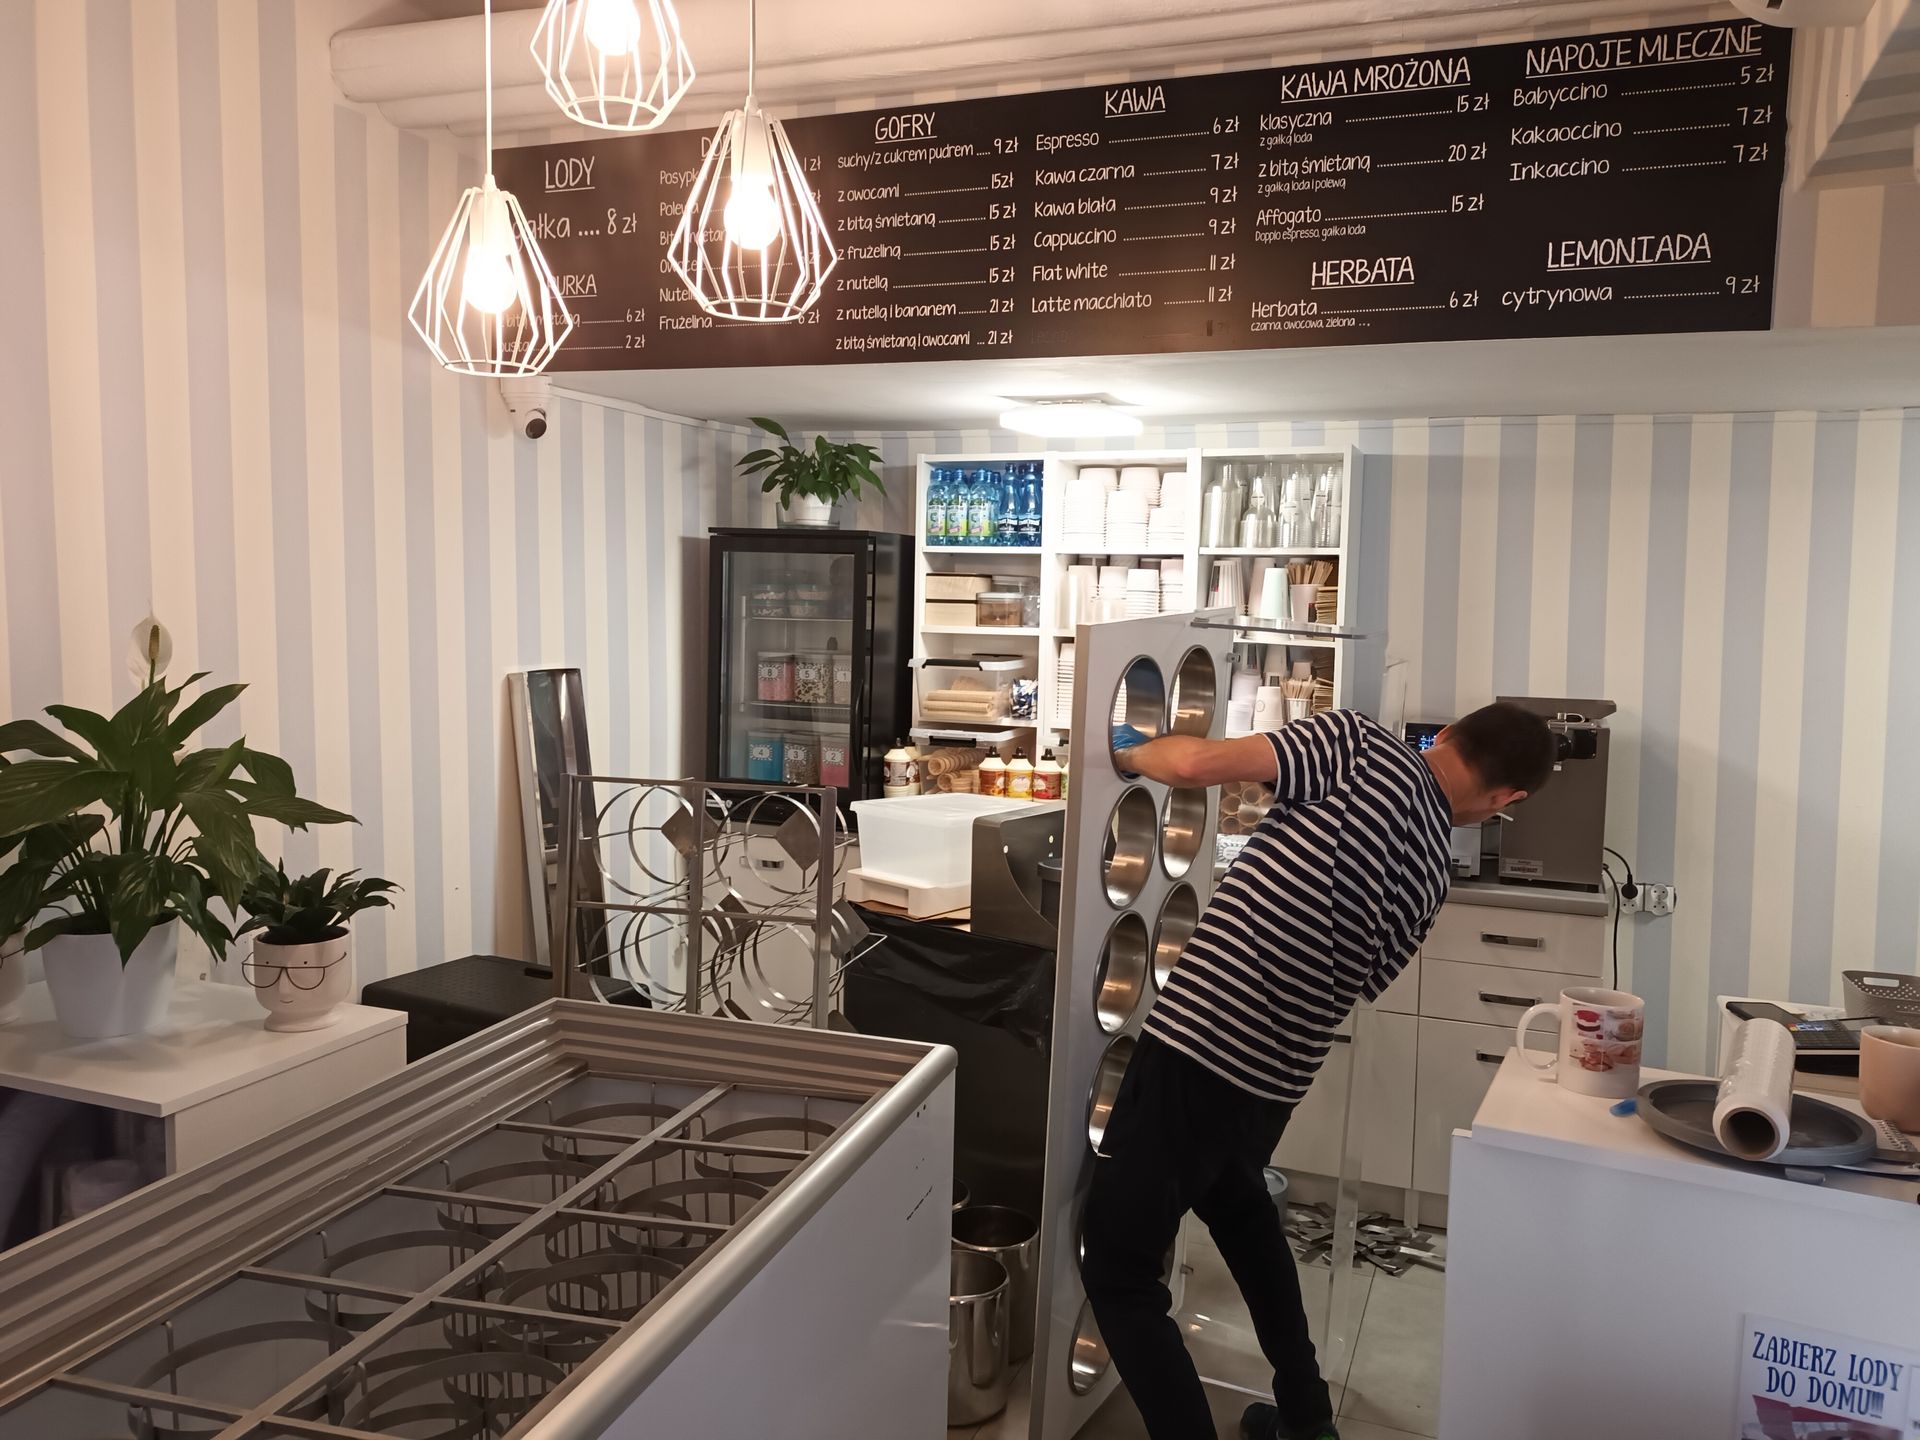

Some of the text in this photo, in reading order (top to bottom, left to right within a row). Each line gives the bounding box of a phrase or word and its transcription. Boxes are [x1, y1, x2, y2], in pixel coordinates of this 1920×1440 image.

[1525, 24, 1763, 75] NAPOJE MLECZNE
[1281, 56, 1471, 100] KAWA MROŻONA
[1513, 64, 1775, 110] Babyccino 5 zł
[1105, 85, 1166, 115] KAWA
[1260, 92, 1490, 134] klasyczna 15 zł
[875, 112, 936, 140] GOFRY
[1036, 115, 1240, 154] Espresso 6 zł
[1511, 105, 1773, 146] Kakaoccino 7 zł
[884, 149, 927, 164] cukrem
[929, 144, 974, 164] pudrem
[994, 139, 1002, 154] 9
[1005, 137, 1019, 153] zł
[1259, 132, 1313, 150] z gałką loda
[545, 155, 595, 189] LODY
[659, 167, 707, 190] Posypk
[810, 155, 821, 171] zł
[1035, 152, 1239, 186] Kawa czarna 7 zł
[1258, 142, 1487, 179] z bitą śmietaną 20 zł
[1509, 142, 1768, 181] Inkaccino 7 zł
[838, 190, 845, 202] z
[847, 184, 900, 201] owocami
[1034, 185, 1238, 217] Kawa biała 9 zł
[1257, 184, 1263, 194] z
[1264, 180, 1290, 197] gałką
[1291, 178, 1310, 191] loda
[1315, 176, 1346, 192] polewą
[607, 208, 617, 235] 8
[622, 212, 638, 234] zł
[838, 219, 845, 231] z
[847, 217, 873, 232] bitą
[875, 213, 936, 230] śmietaną
[990, 204, 1000, 220] 15
[1003, 202, 1016, 219] zł
[1255, 193, 1484, 230] Affogato 15 zł
[837, 234, 1016, 260] z frużeliną 15 zł
[1033, 217, 1236, 252] Cappuccino 9 zł
[1255, 230, 1281, 244] Doppio
[1321, 225, 1346, 242] gałka
[1347, 224, 1366, 236] loda
[1547, 232, 1711, 268] LEMONIADA
[659, 258, 698, 274] Owe
[837, 266, 1015, 291] z nutellą 15 zł
[1032, 253, 1235, 282] Flat white 11 zł
[1311, 256, 1415, 286] HERBATA
[546, 273, 598, 296] URKA
[659, 287, 700, 303] Nutell
[1032, 285, 1233, 313] Latte macchiato 11 zł
[1501, 274, 1760, 312] cytrynowa 9 zł
[626, 308, 633, 323] 6
[635, 308, 645, 323] zł
[836, 309, 844, 320] z
[846, 304, 888, 321] nutellą
[895, 303, 957, 318] bananem
[989, 299, 999, 314] 21
[1001, 298, 1014, 313] zł
[1251, 290, 1479, 318] Herbata 6 zł
[659, 315, 712, 331] Frużelina
[808, 309, 820, 324] zł
[1325, 316, 1356, 328] zielona
[625, 334, 632, 349] 2
[634, 334, 645, 349] zł
[836, 338, 842, 350] z
[843, 337, 865, 352] bitą
[866, 334, 917, 350] śmietaną
[922, 331, 970, 347] owocami
[987, 330, 997, 345] 21
[1000, 329, 1013, 345] zł
[1752, 1331, 1904, 1392] ZABIERZ LODY
[1766, 1366, 1796, 1398] DO
